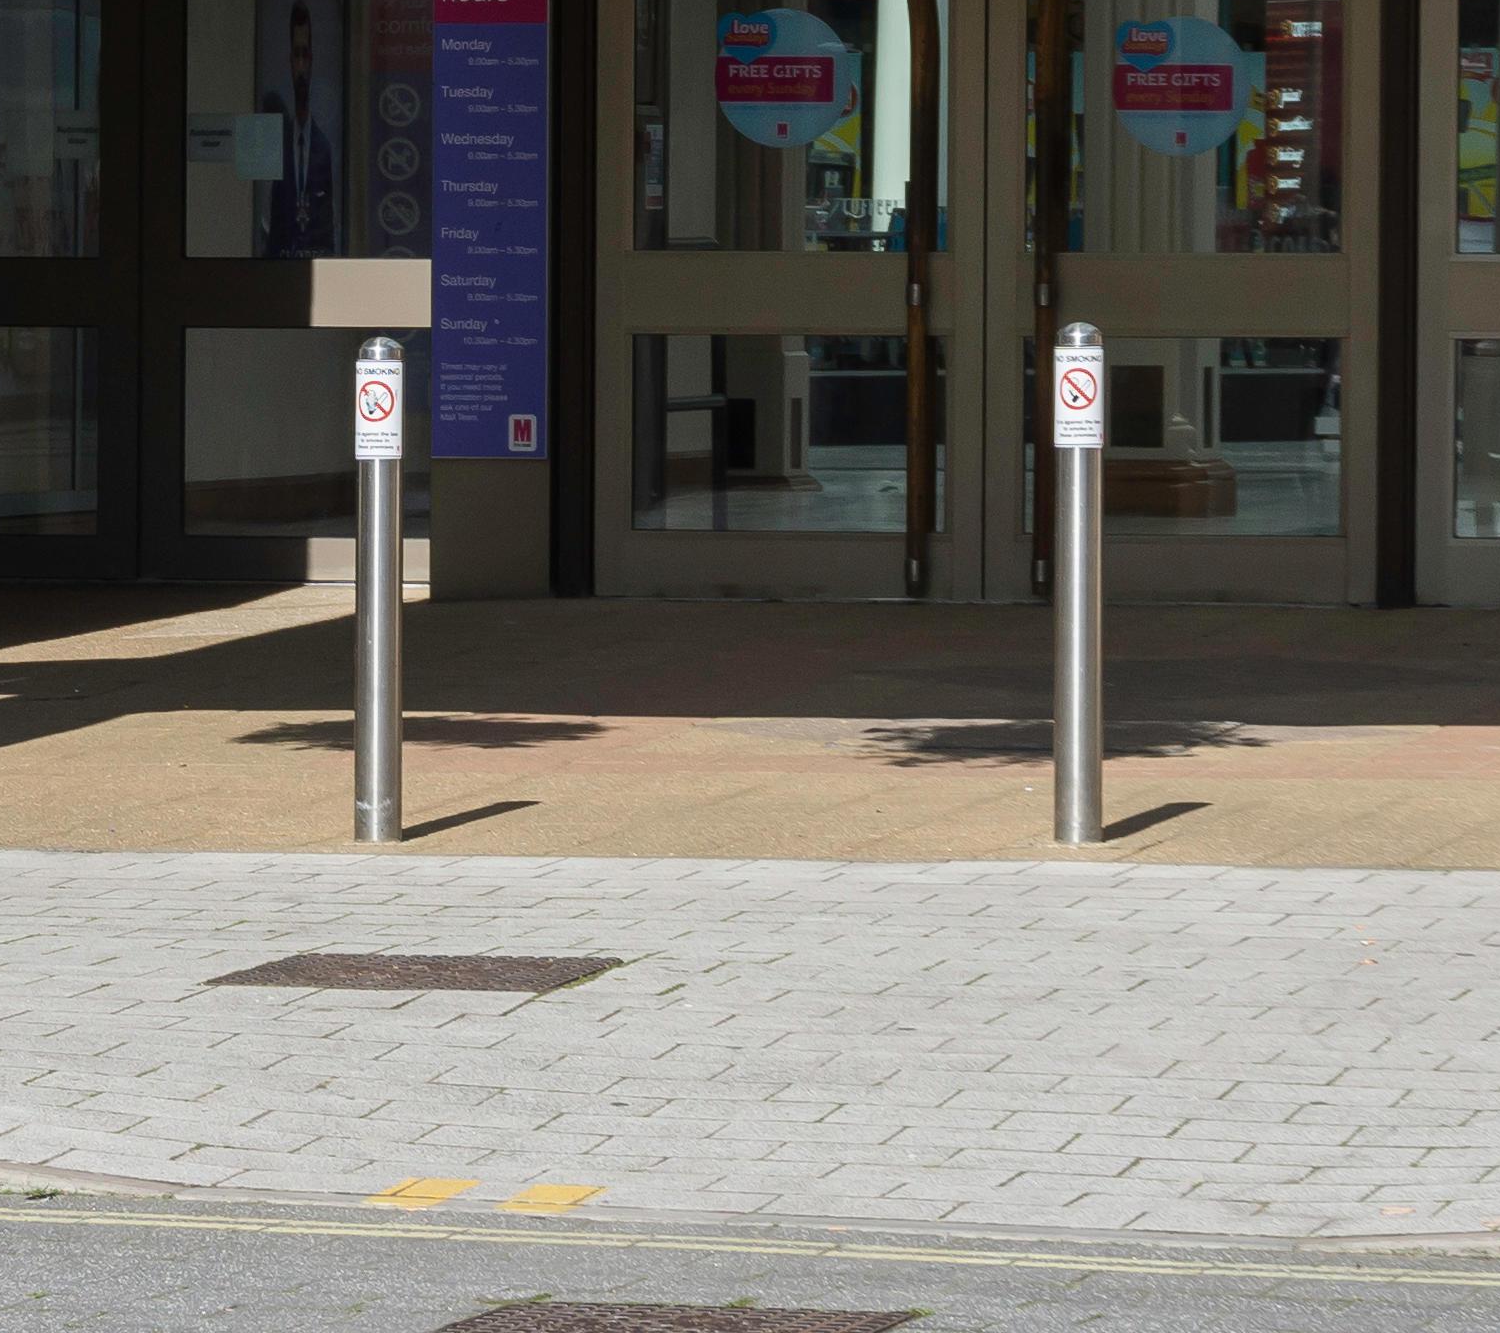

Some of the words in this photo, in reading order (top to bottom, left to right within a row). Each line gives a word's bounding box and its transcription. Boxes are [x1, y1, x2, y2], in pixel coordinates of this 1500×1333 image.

[733, 19, 769, 34] love
[1130, 28, 1168, 42] love
[442, 39, 492, 52] Monday
[728, 65, 769, 78] FREE
[773, 65, 822, 78] GIFTS
[1127, 73, 1168, 86] FREE
[1171, 73, 1221, 86] GIFTS
[442, 86, 494, 99] Tuesday
[728, 84, 763, 97] every
[767, 82, 817, 96] Sunday
[441, 133, 514, 147] Wednesday
[441, 180, 498, 194] Thursday
[441, 227, 479, 241] Friday
[441, 275, 497, 289] Saturday
[440, 318, 487, 332] Sunday
[513, 419, 532, 442] M
